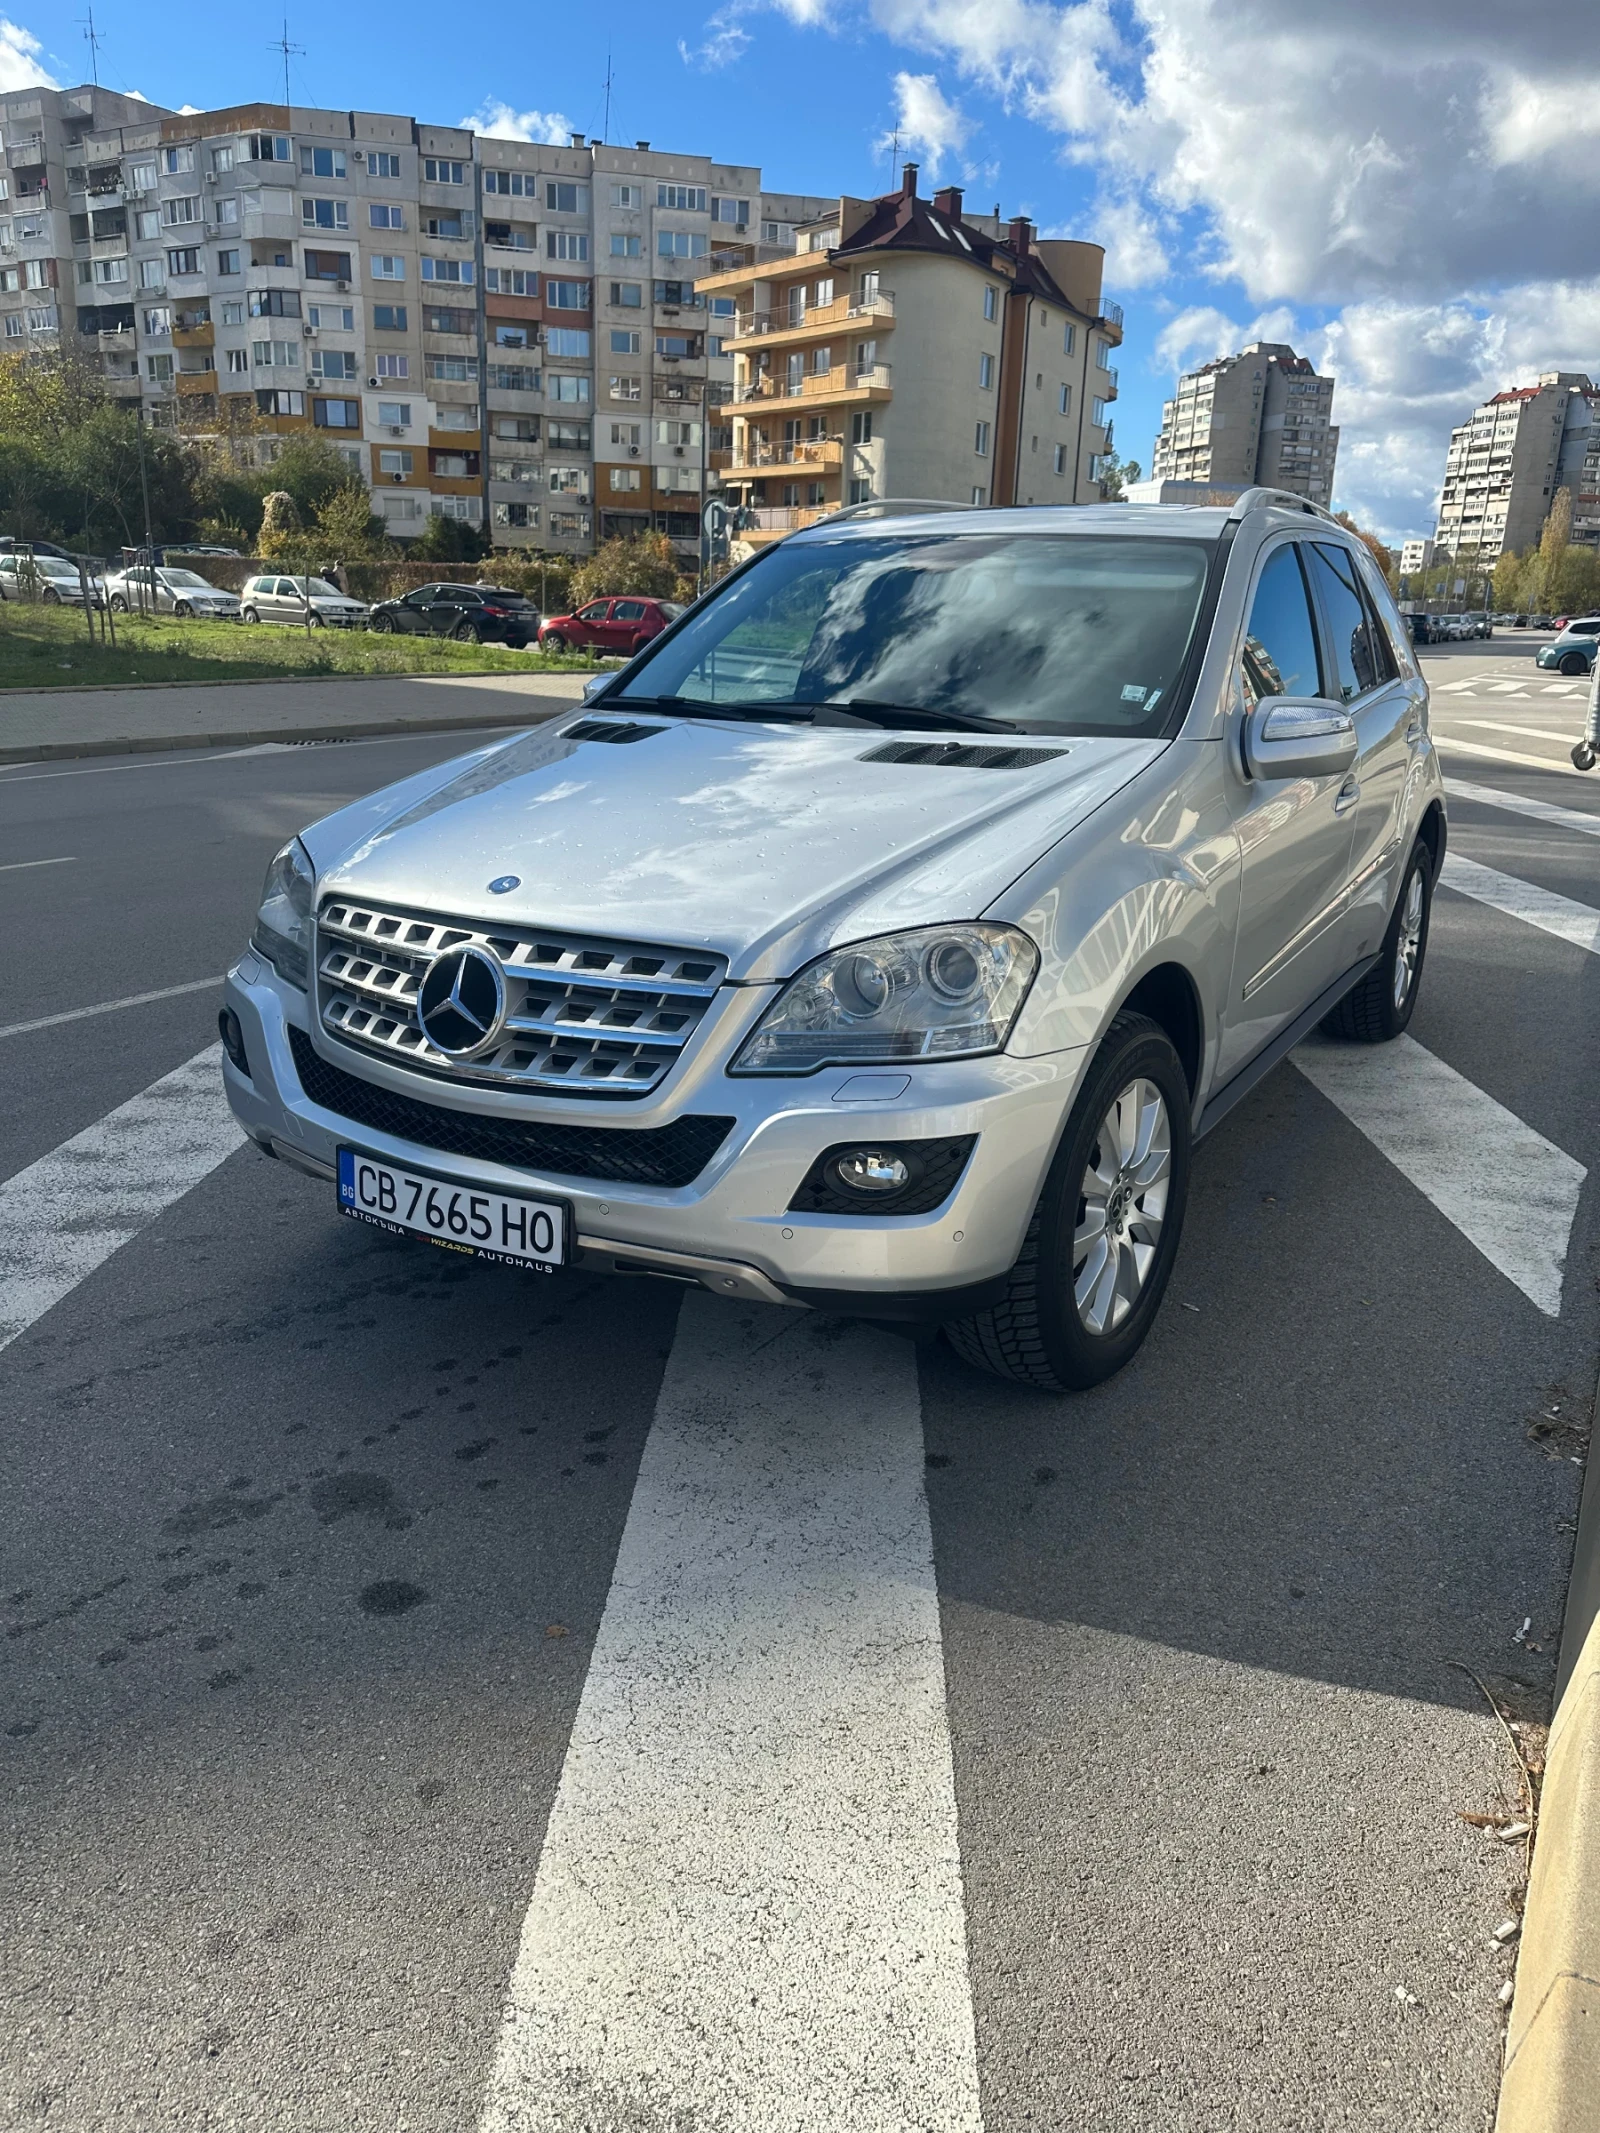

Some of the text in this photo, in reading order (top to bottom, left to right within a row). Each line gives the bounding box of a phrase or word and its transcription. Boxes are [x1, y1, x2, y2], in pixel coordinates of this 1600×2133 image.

[342, 1183, 354, 1199] BG
[344, 1207, 405, 1235] АВТОКЪЩА
[430, 1237, 475, 1255] WIZARDS
[477, 1250, 554, 1274] AUTOHAUS
